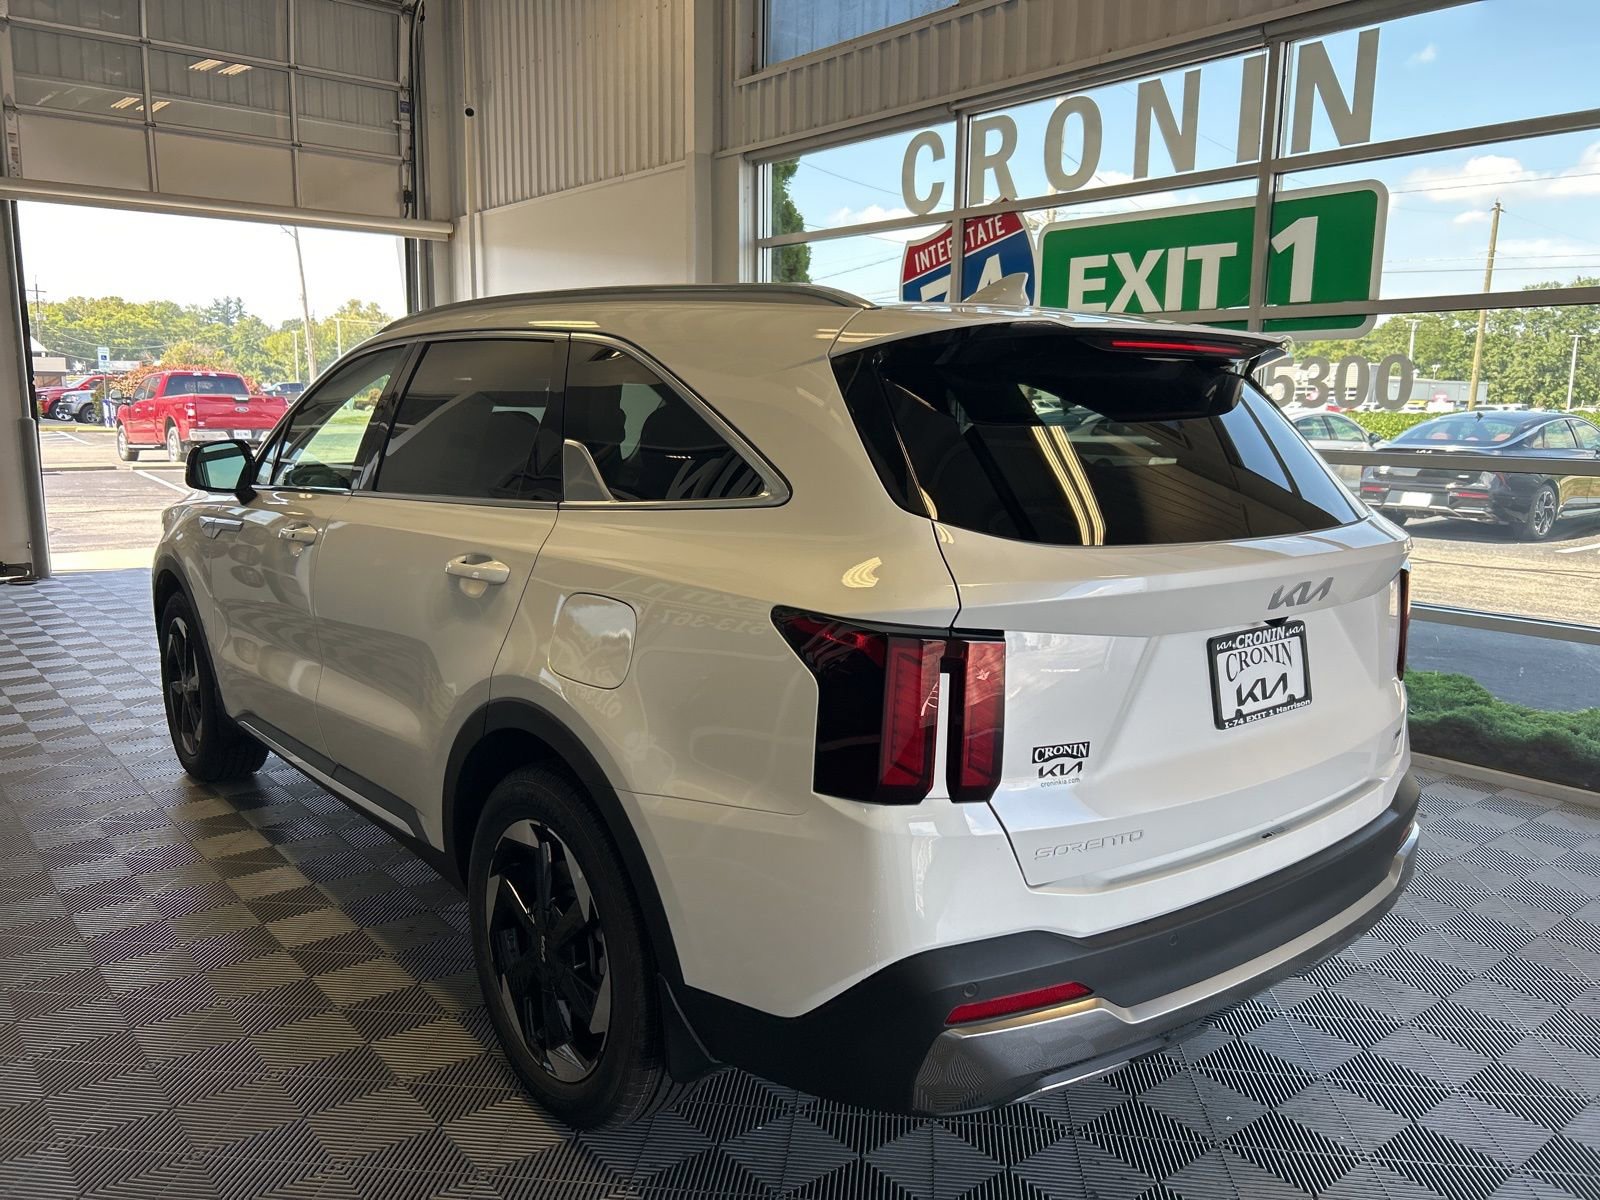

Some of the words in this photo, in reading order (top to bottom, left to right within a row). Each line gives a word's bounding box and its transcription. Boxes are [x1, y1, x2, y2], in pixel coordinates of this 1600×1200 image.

[901, 28, 1380, 215] CRONIN
[914, 215, 1006, 273] INTERTATE
[1068, 242, 1238, 313] EXIT
[1271, 216, 1319, 304] 1
[1264, 354, 1415, 411] 5300
[1267, 576, 1334, 610] KIA
[1235, 626, 1286, 649] CRONIN
[1225, 640, 1293, 682] CRONIN
[1236, 672, 1288, 707] KIA
[1224, 716, 1244, 729] I-74
[1246, 711, 1268, 723] EXIT
[1276, 699, 1311, 714] Harrison
[1034, 743, 1088, 762] CRONIN
[1038, 761, 1083, 779] KIA
[1040, 777, 1081, 788] croninkia.com
[1034, 829, 1144, 860] SORENTO
